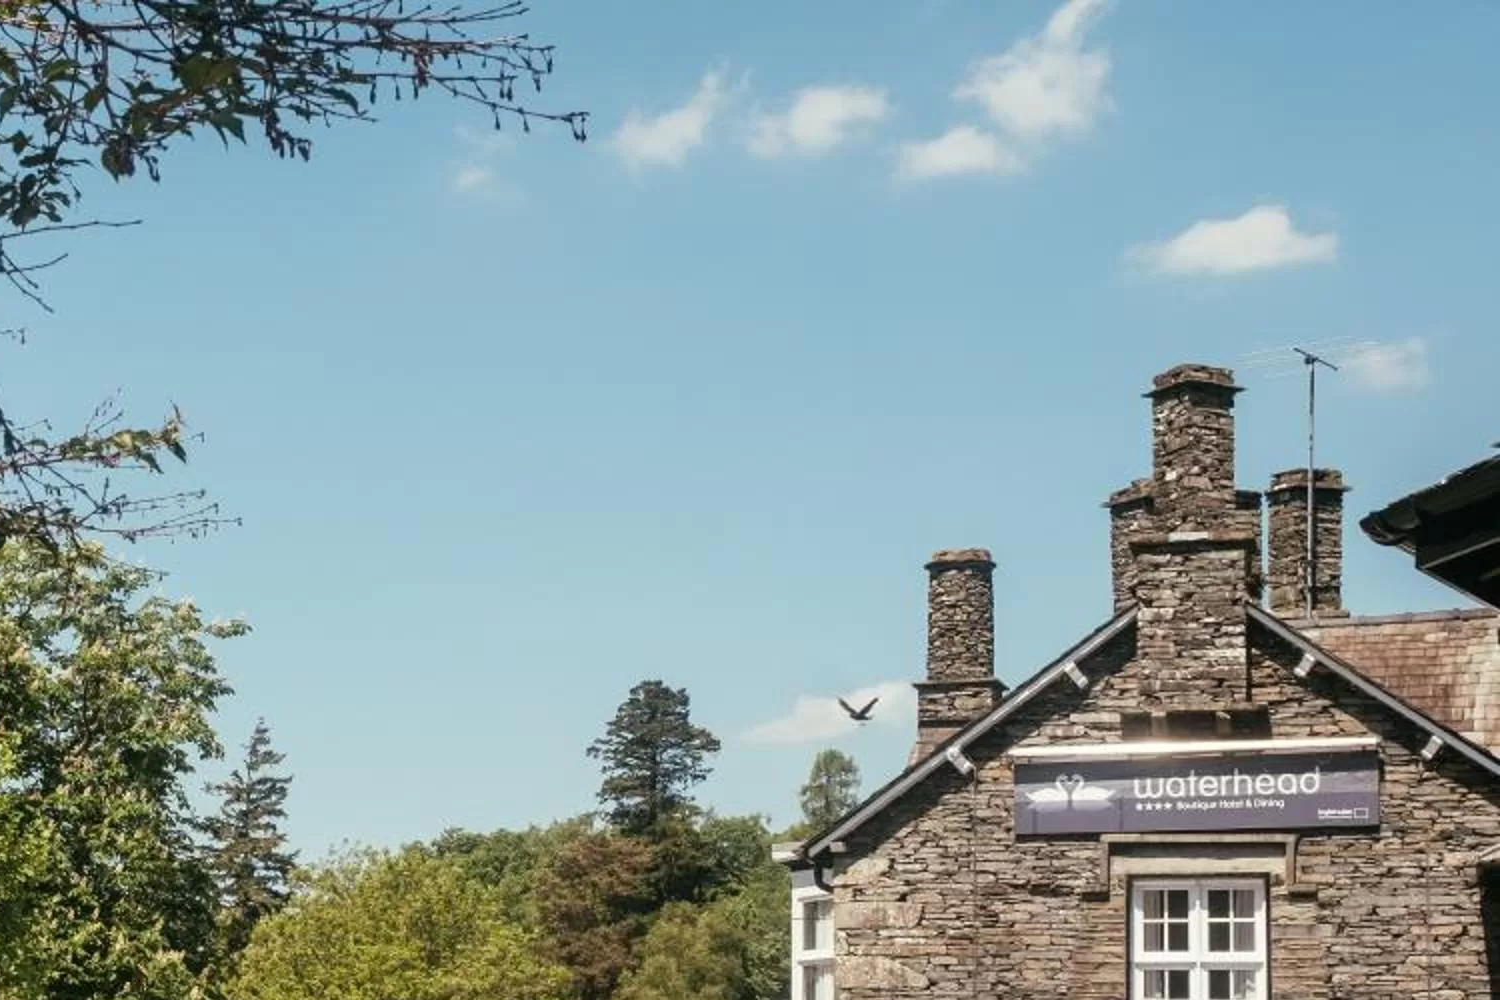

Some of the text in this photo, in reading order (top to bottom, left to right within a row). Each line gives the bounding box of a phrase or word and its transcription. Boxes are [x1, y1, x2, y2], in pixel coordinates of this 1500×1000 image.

[1133, 766, 1320, 798] waterhead
[1176, 800, 1217, 811] Boutique
[1219, 800, 1244, 809] Hotel
[1254, 799, 1285, 809] Dining
